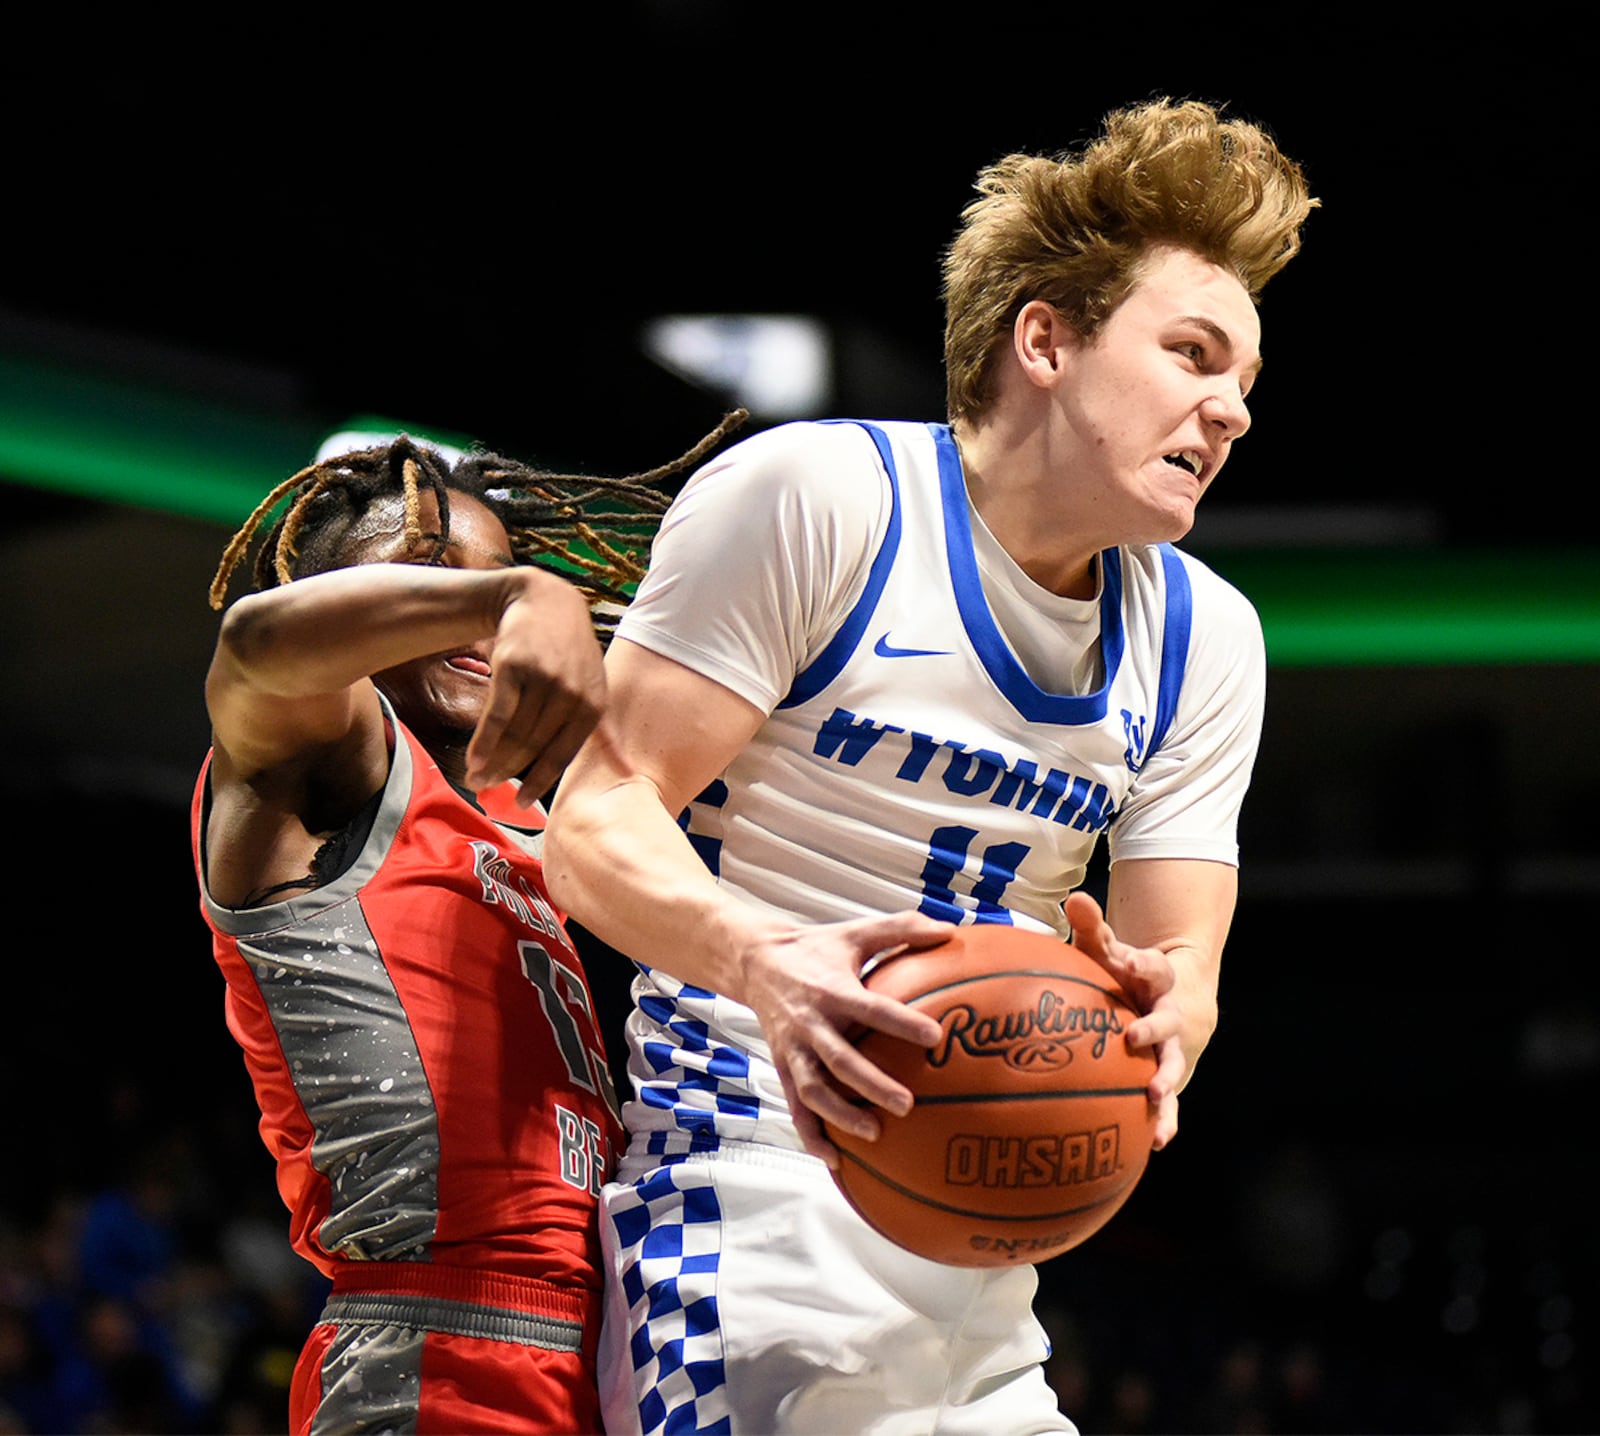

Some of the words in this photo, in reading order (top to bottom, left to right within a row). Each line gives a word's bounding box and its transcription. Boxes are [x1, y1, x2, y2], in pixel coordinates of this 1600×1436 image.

[812, 707, 1115, 834] WYOMIN
[917, 825, 1032, 927] 11
[926, 990, 1123, 1068] Rawlings
[553, 1103, 618, 1200] BE
[945, 1123, 1121, 1189] OHSAA
